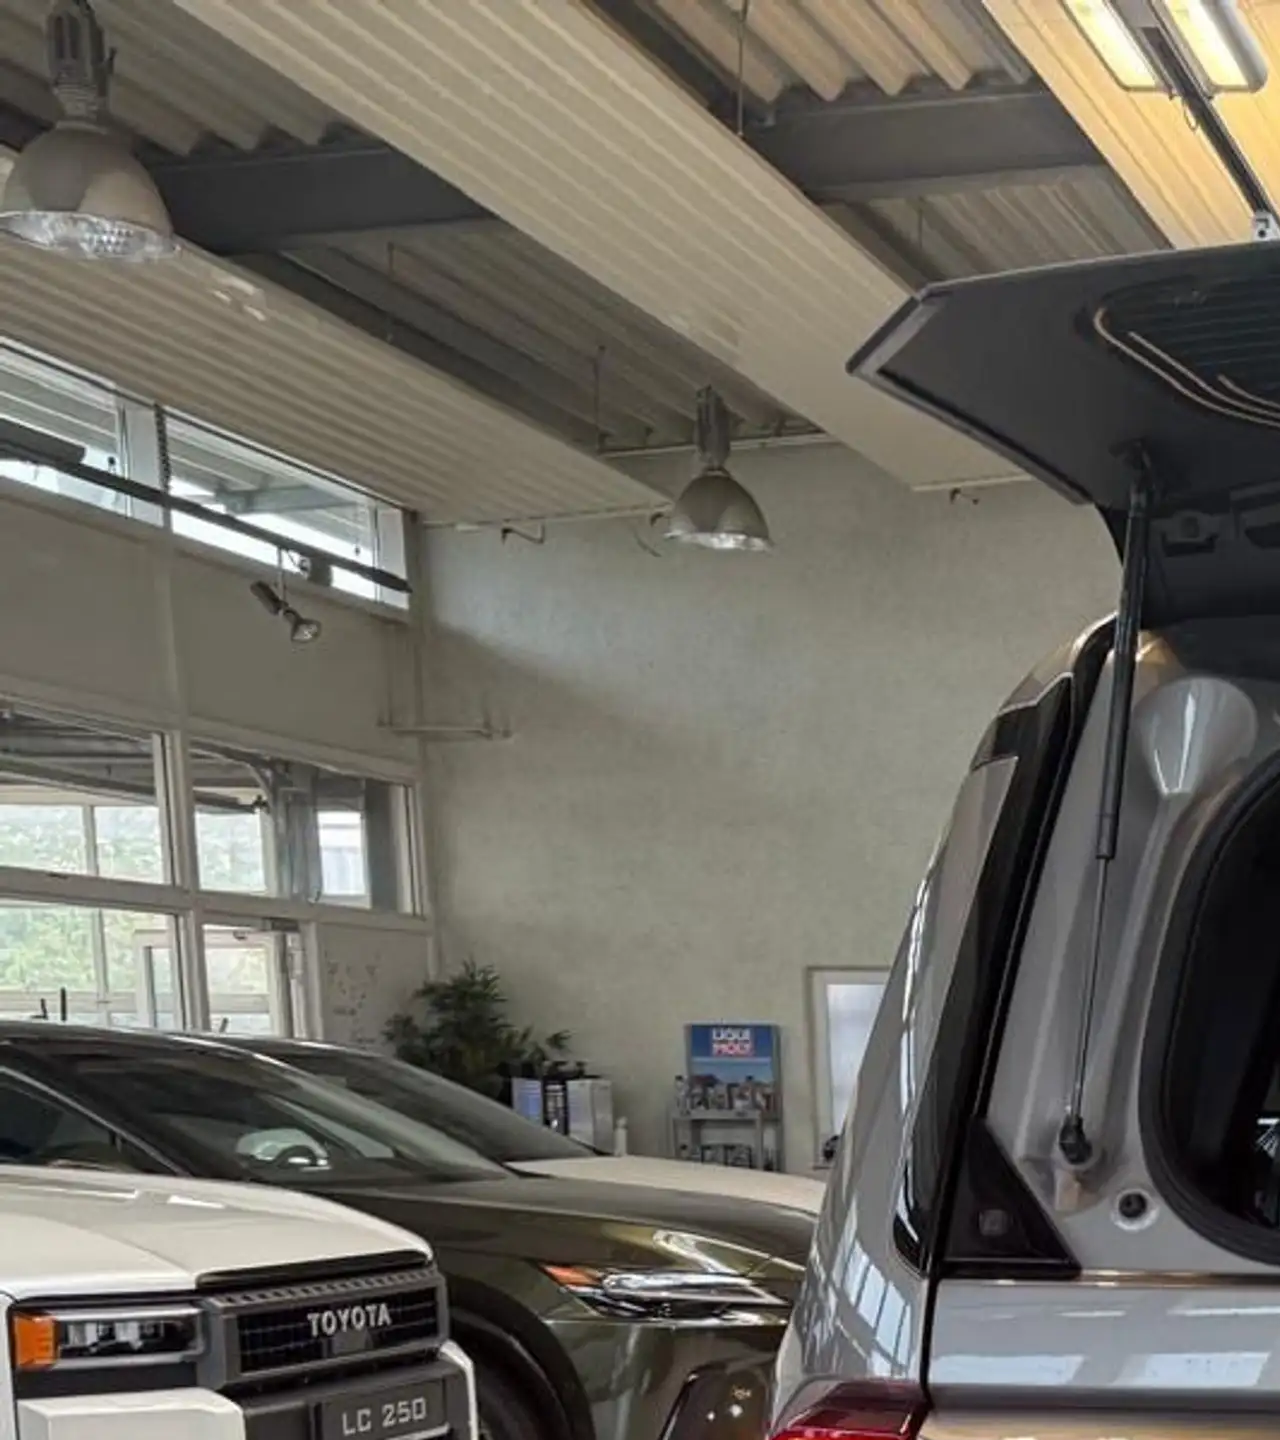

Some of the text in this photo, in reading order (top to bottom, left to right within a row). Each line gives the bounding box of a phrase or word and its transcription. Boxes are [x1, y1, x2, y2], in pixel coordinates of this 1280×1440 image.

[307, 1303, 392, 1337] TOYOTA
[342, 1397, 427, 1436] LC 250
